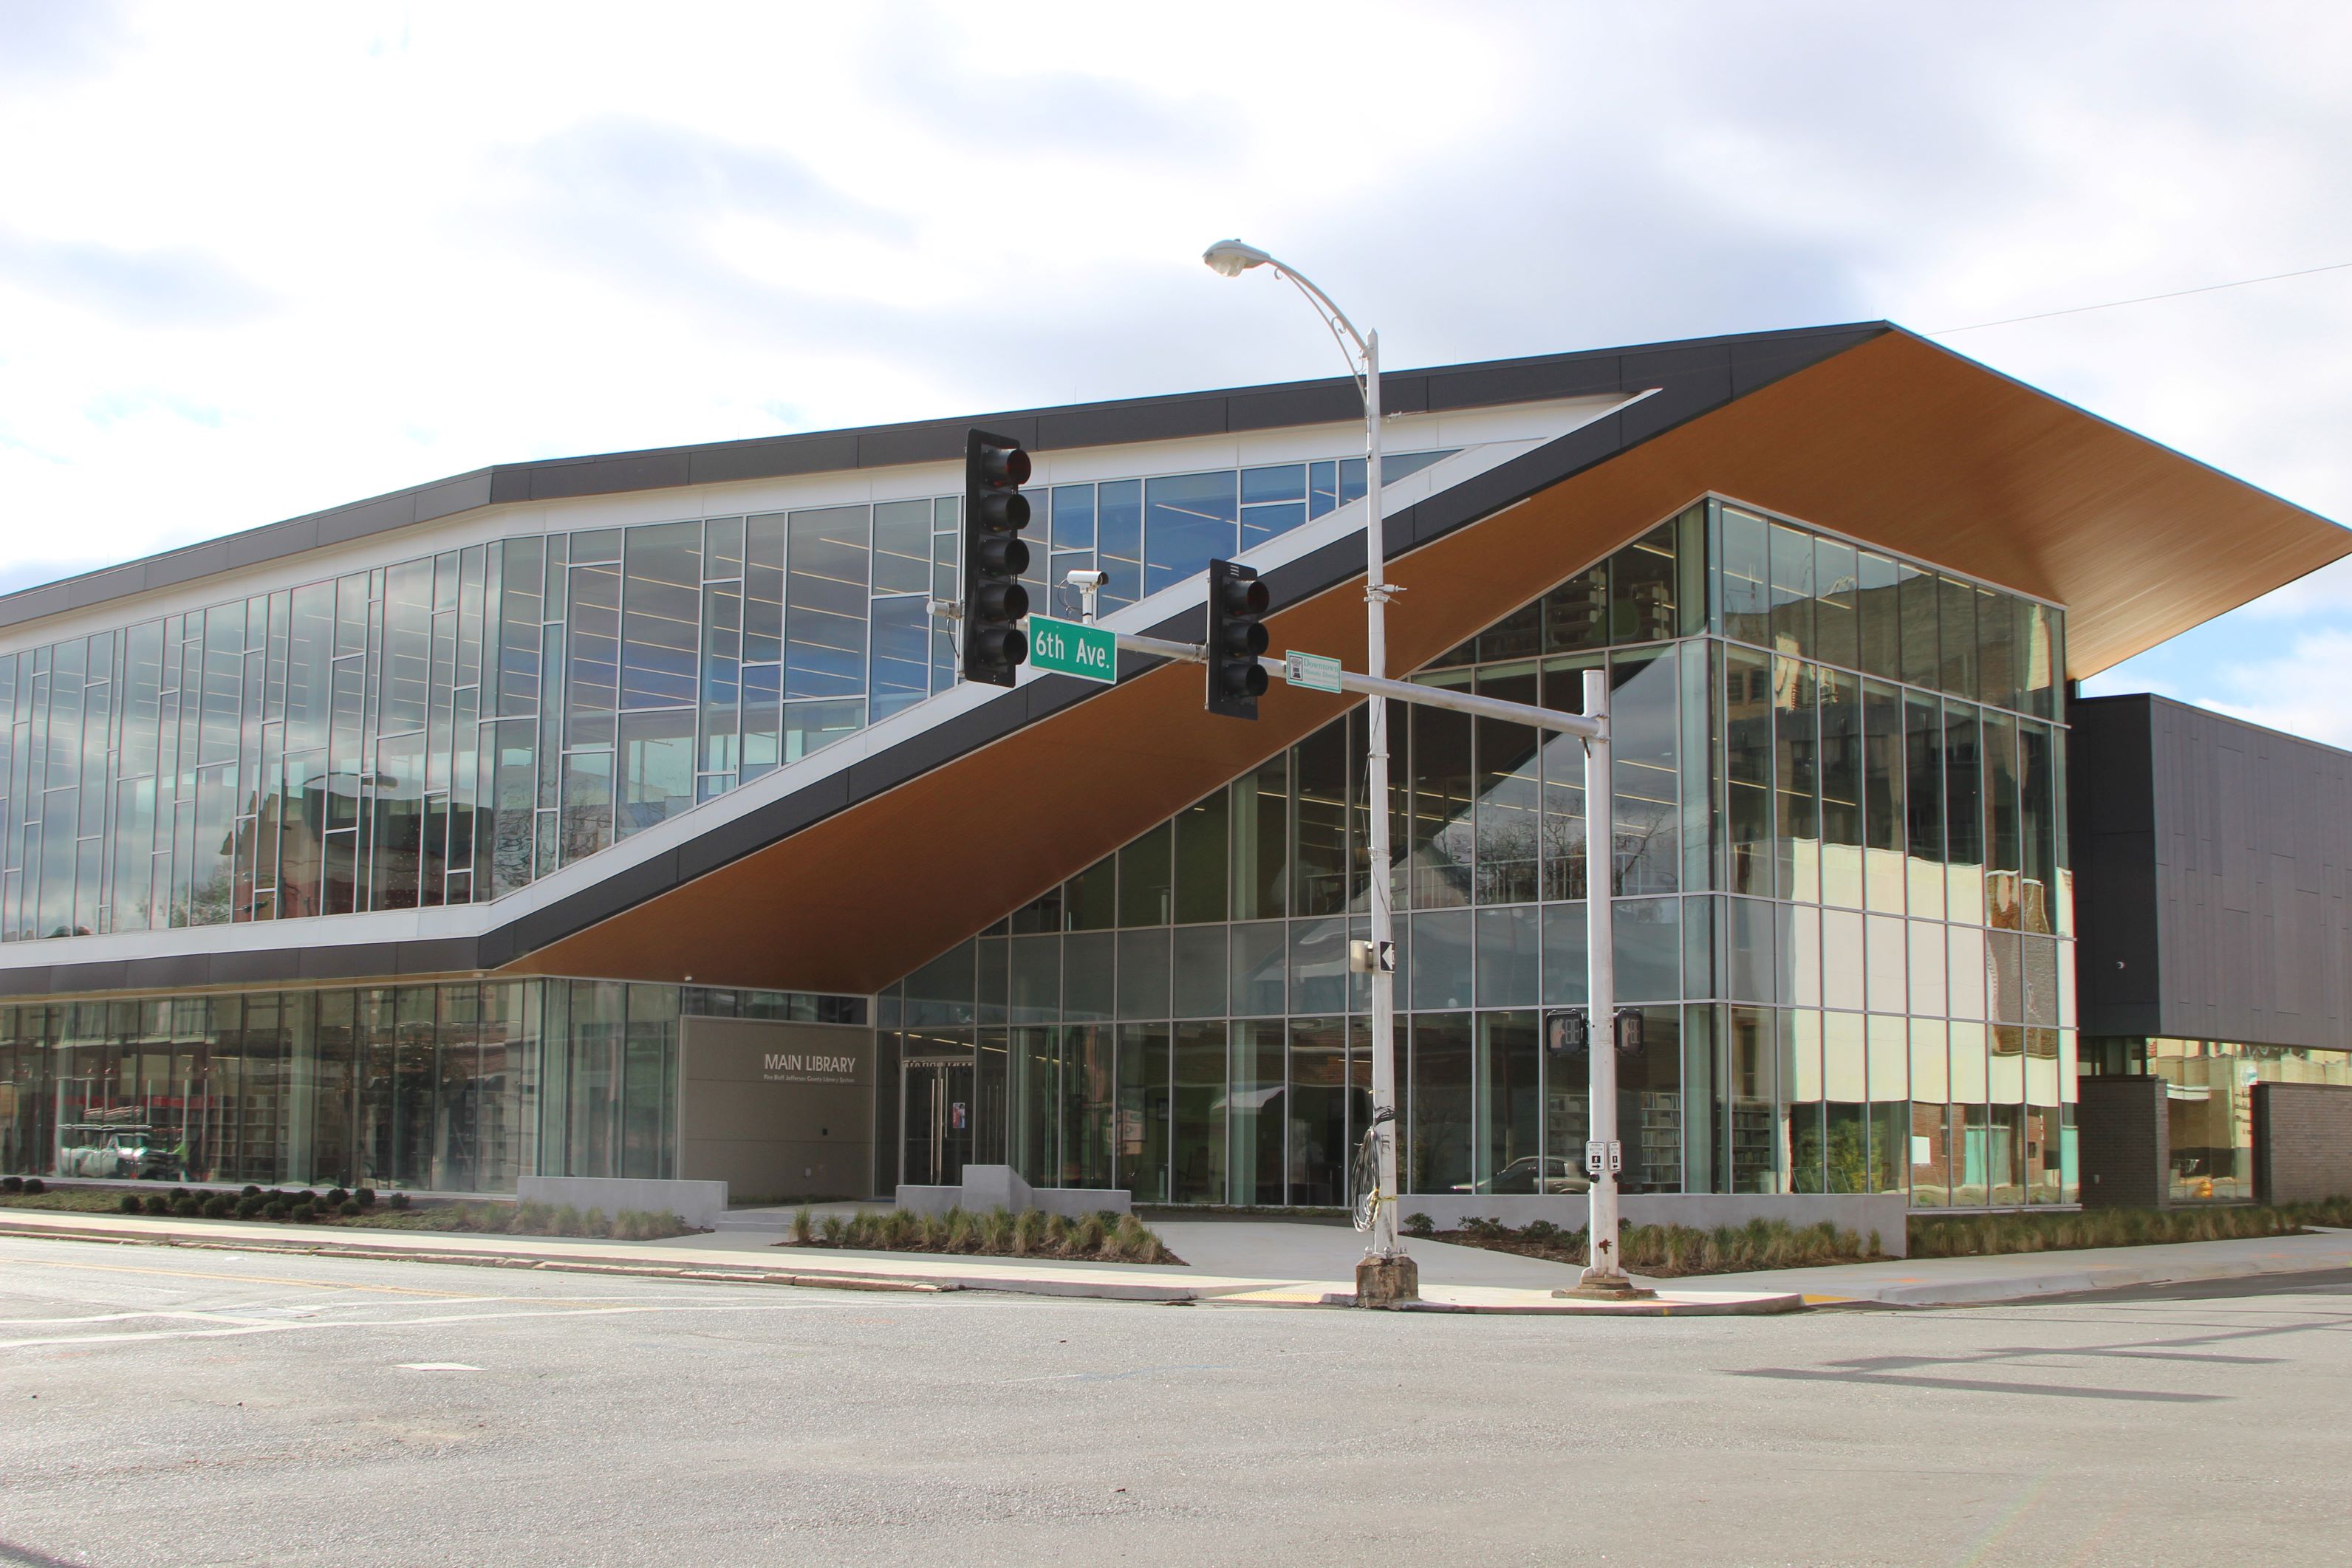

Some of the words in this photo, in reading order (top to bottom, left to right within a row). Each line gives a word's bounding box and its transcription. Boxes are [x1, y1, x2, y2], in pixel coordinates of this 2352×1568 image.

[1036, 630, 1064, 660] 6th
[1076, 637, 1110, 669] Ave.
[1303, 658, 1338, 672] Downtown
[765, 1054, 801, 1070] MAIN
[806, 1055, 856, 1073] LIBRARY
